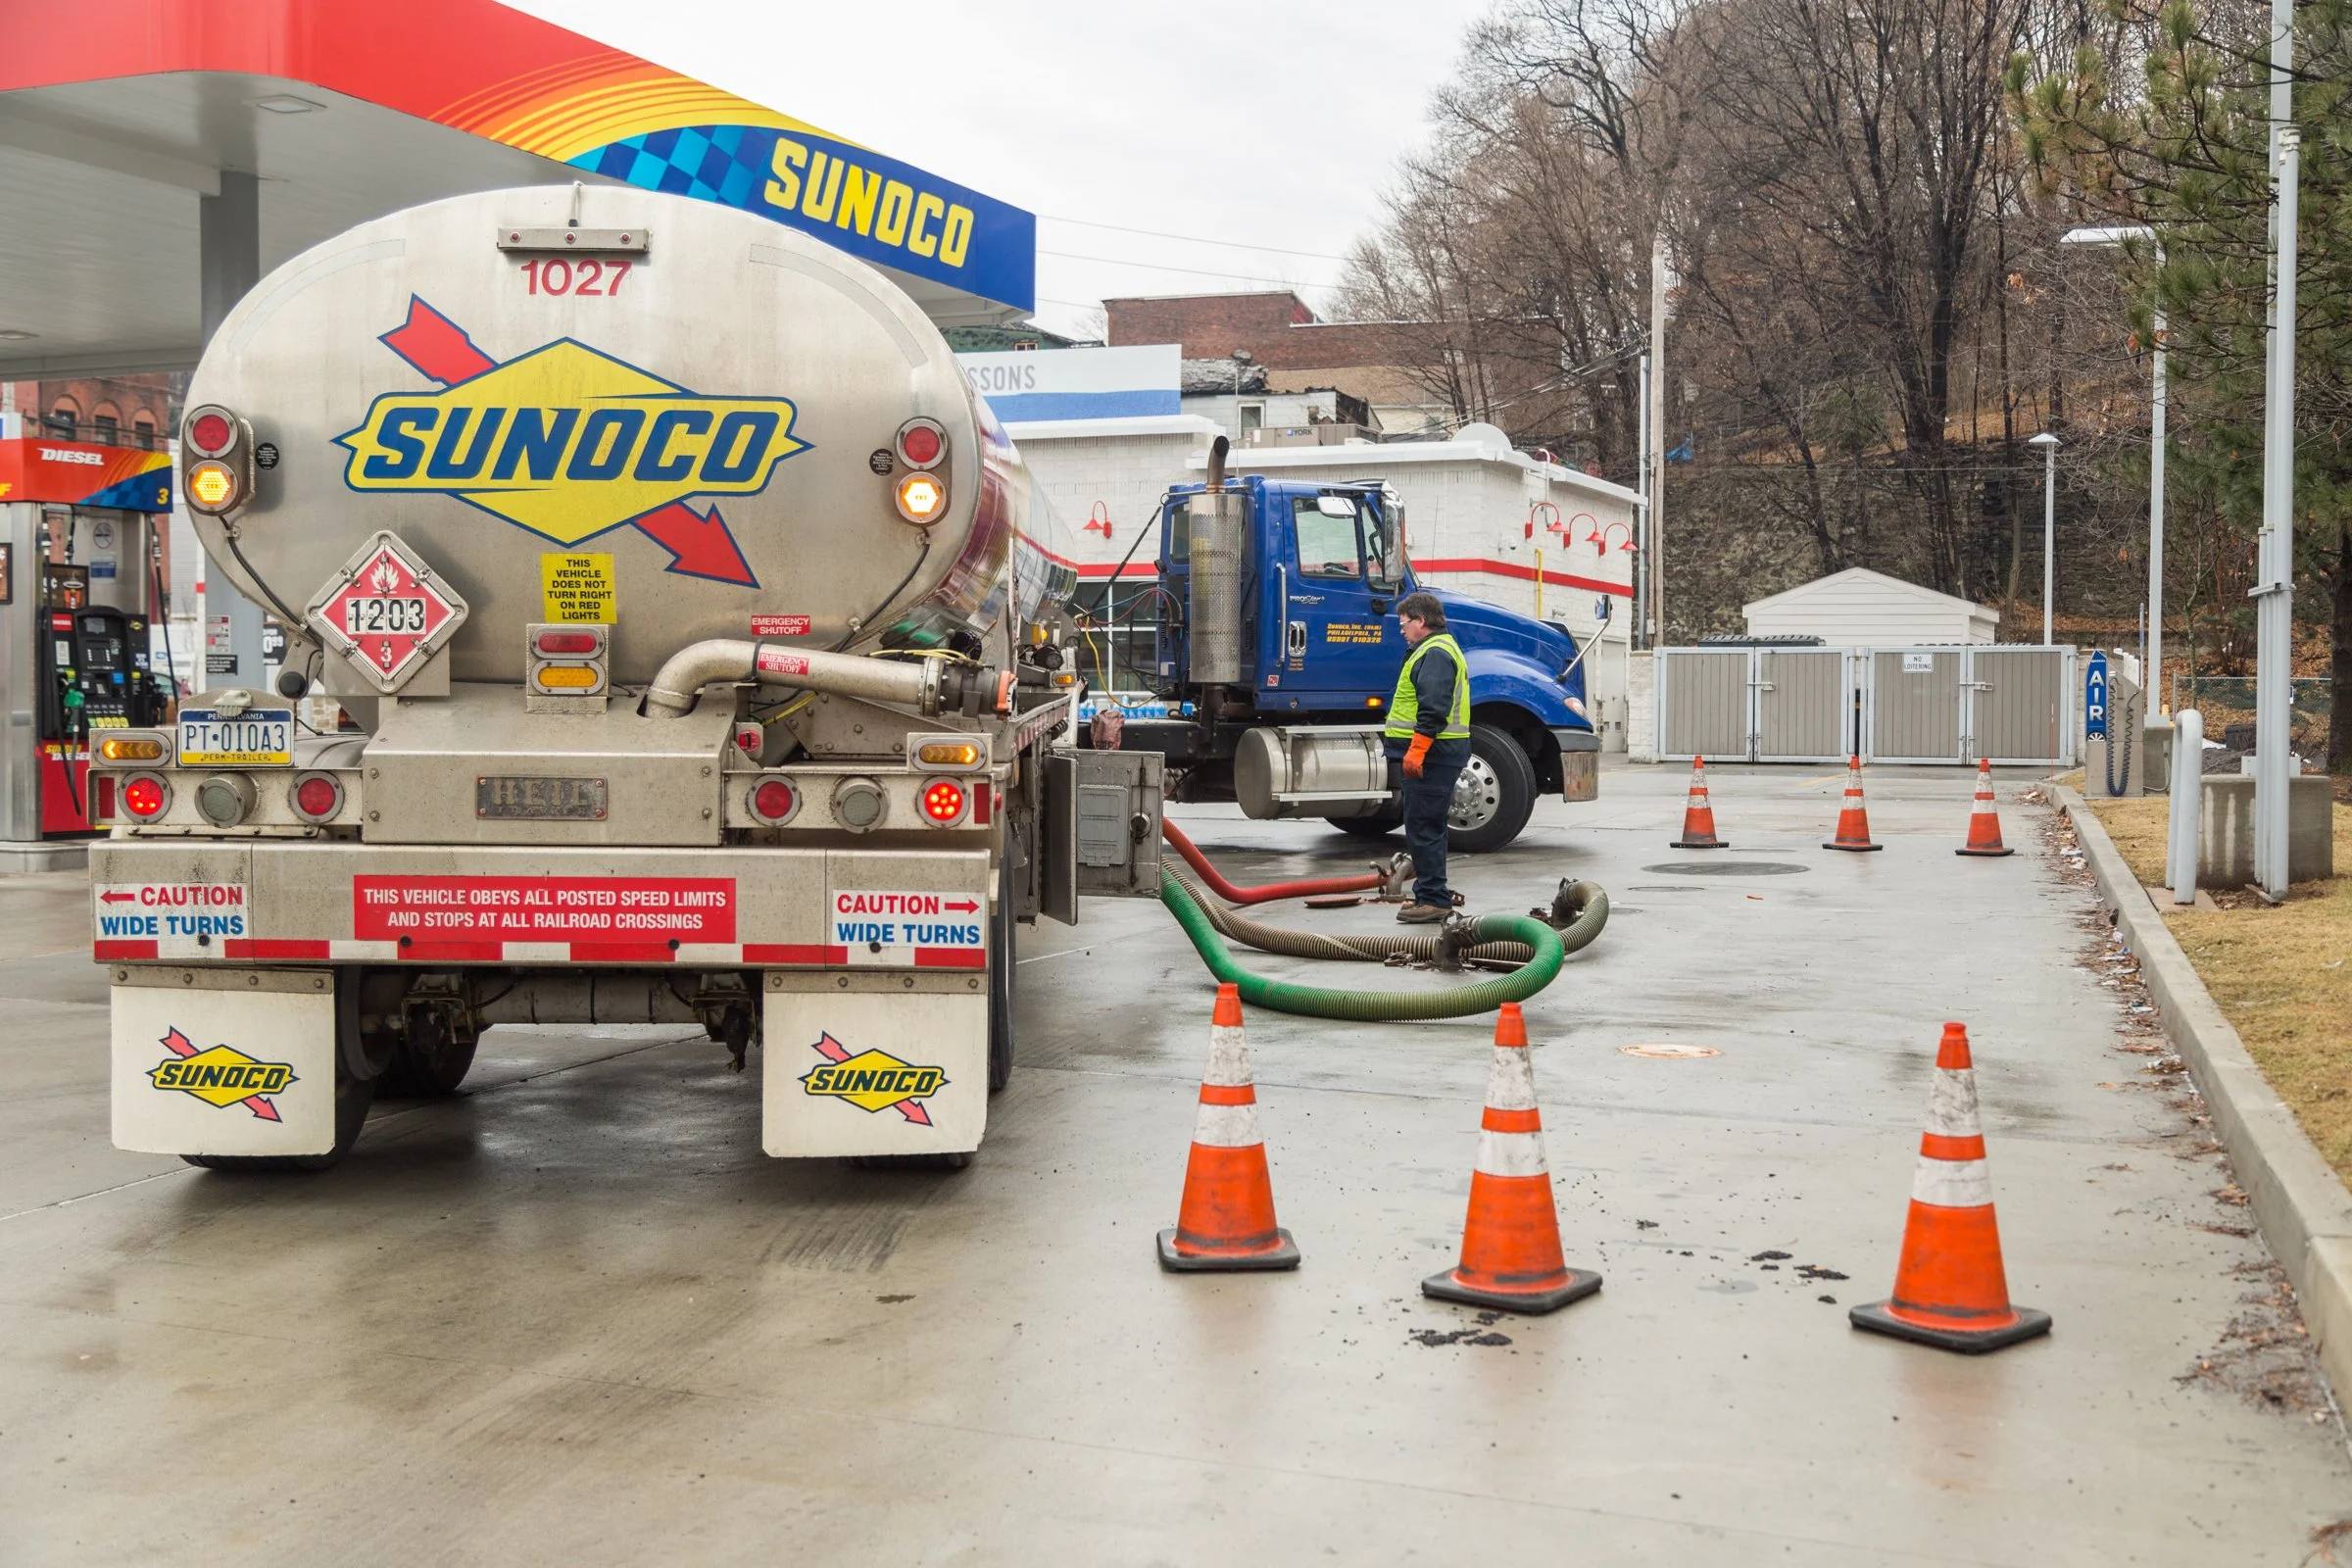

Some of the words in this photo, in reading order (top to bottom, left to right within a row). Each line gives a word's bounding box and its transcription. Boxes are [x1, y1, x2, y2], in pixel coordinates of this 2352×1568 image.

[764, 137, 974, 269] SUNOCO
[520, 259, 632, 297] 1027
[363, 407, 780, 483] SUNOCO
[38, 448, 105, 466] DIESEL
[157, 488, 170, 505] 3
[556, 569, 601, 578] VEHICLE
[560, 601, 575, 610] ON
[578, 601, 601, 610] RED
[351, 599, 424, 632] 1203
[752, 617, 809, 626] EMERGENCY
[760, 626, 803, 635] SHUTOFF
[380, 646, 393, 663] 3
[760, 653, 808, 666] EMERGENCY
[765, 662, 802, 673] SHUTOFF
[2088, 670, 2104, 721] AIR
[45, 744, 82, 754] SUNOO
[493, 777, 589, 807] HEIL
[140, 885, 243, 906] CAUTION
[365, 889, 399, 905] THIS
[403, 889, 466, 905] VEHICLE
[470, 889, 520, 906] OBEYS
[524, 890, 553, 906] ALL
[557, 890, 616, 906] POSTED
[620, 891, 670, 906] SPEED
[674, 891, 726, 907] LIMITS
[837, 894, 940, 914] CAUTION
[100, 916, 159, 935] WIDE
[166, 914, 244, 936] TURNS
[387, 911, 420, 927] AND
[424, 911, 474, 927] STOPS
[478, 912, 498, 927] AT
[501, 912, 530, 927] ALL
[534, 912, 612, 928] RAILROAD
[615, 913, 704, 929] CROSSINGS
[837, 922, 895, 942] WIDE
[903, 924, 980, 944] TURNS
[159, 1063, 286, 1089] SUNOCO
[810, 1069, 938, 1093] SUNOCO
